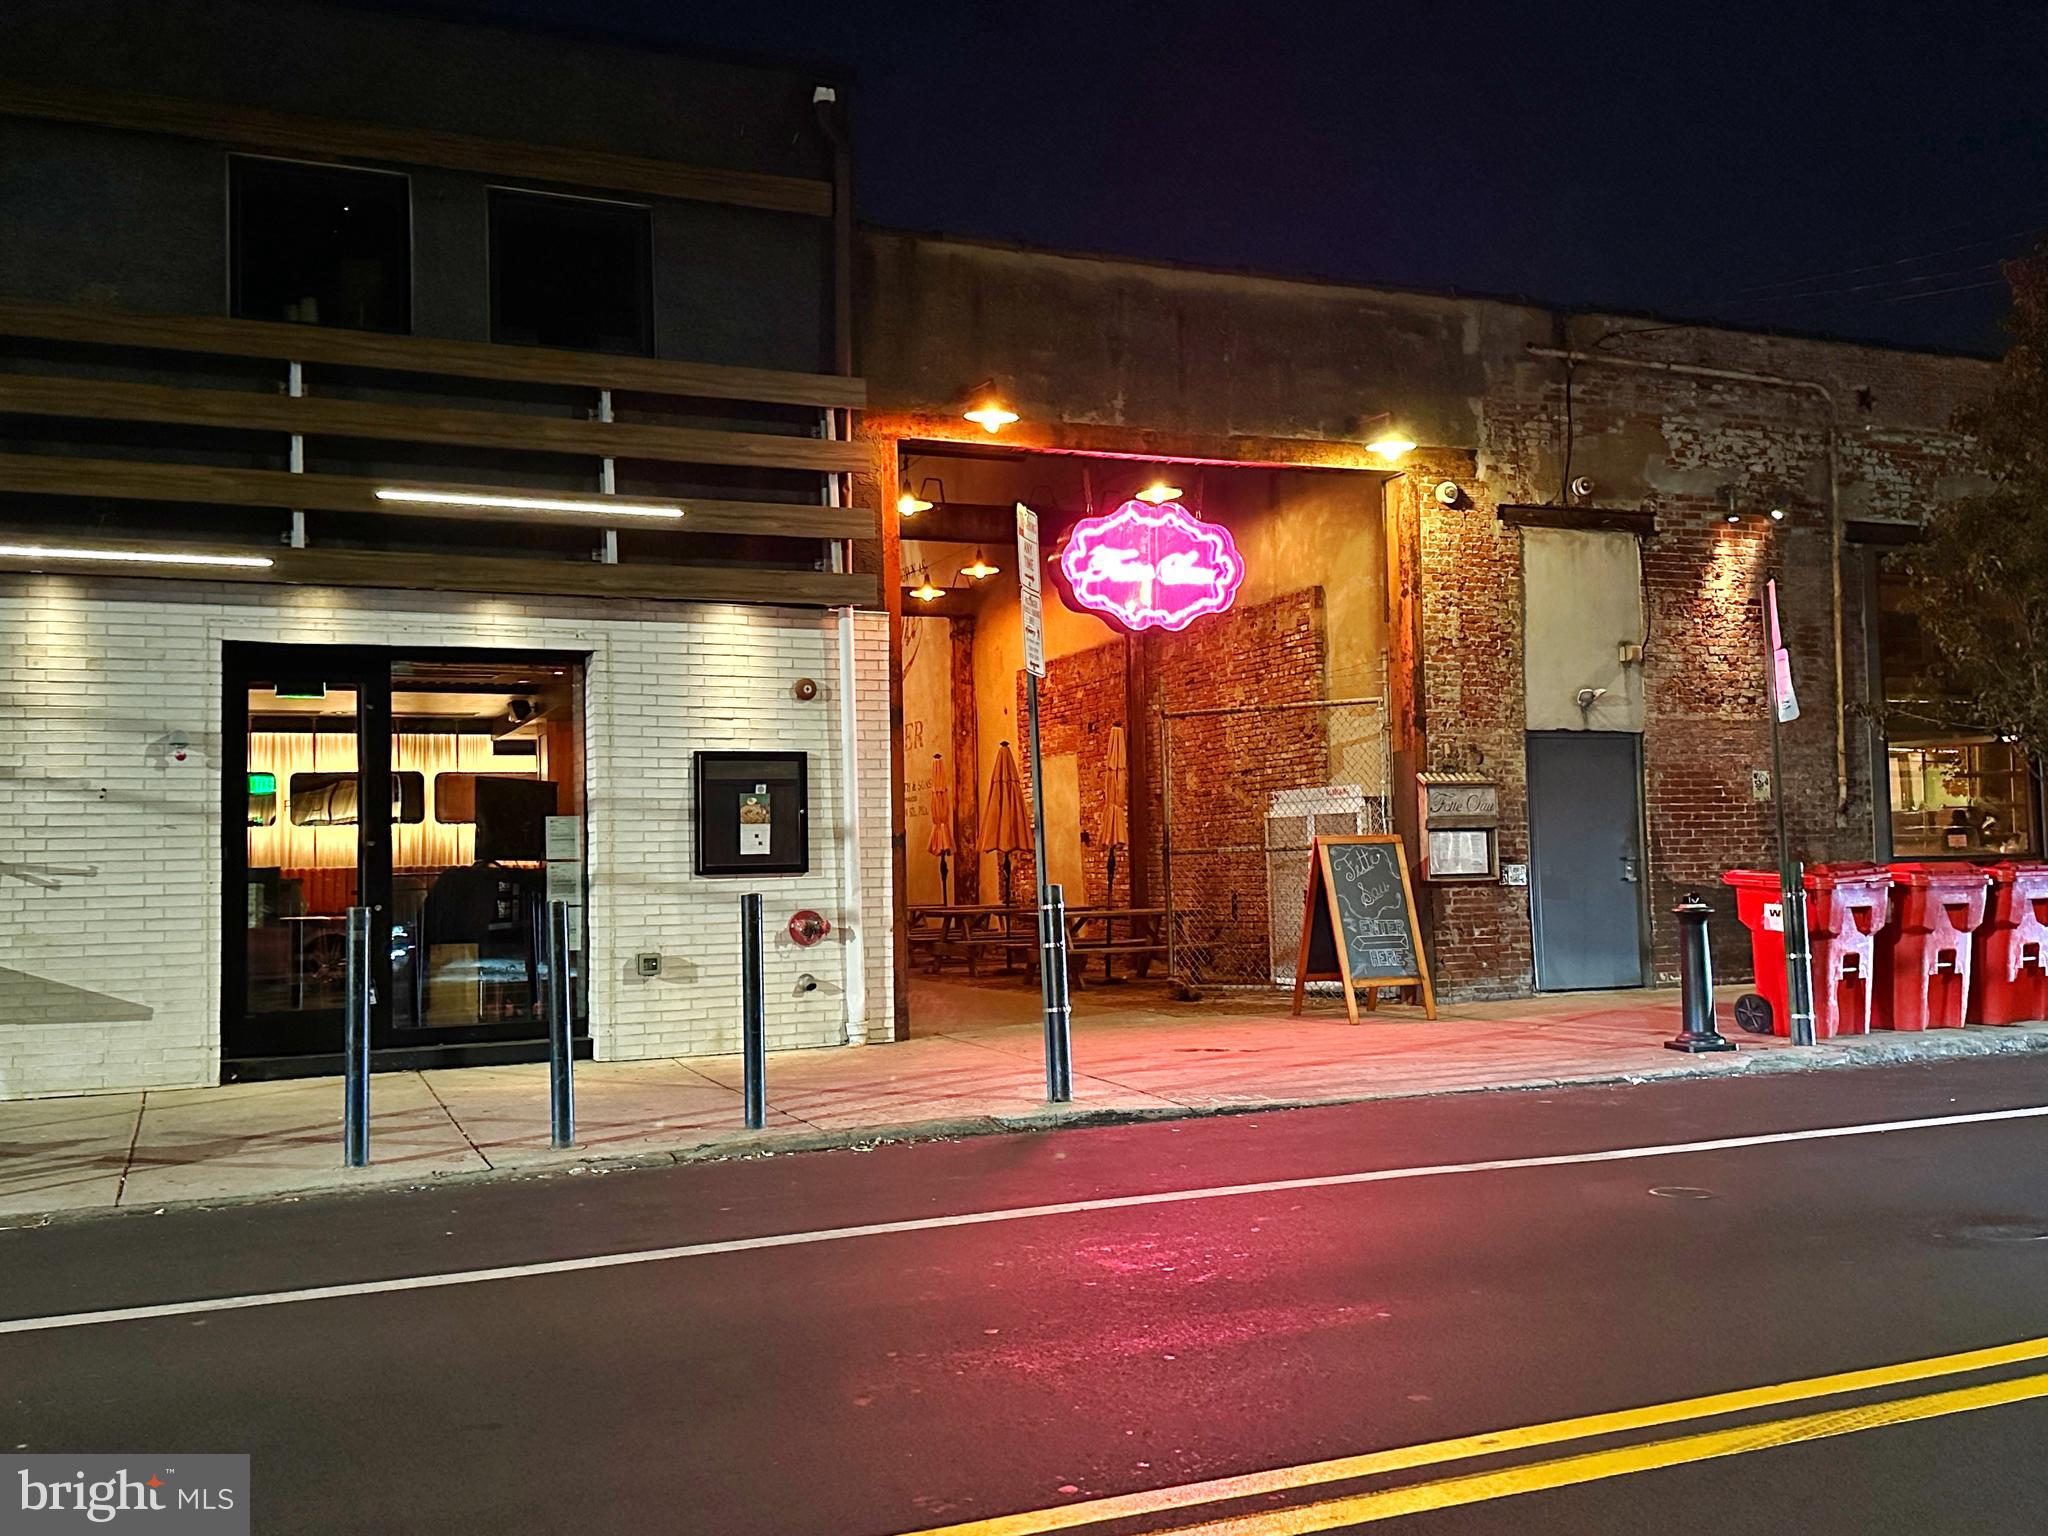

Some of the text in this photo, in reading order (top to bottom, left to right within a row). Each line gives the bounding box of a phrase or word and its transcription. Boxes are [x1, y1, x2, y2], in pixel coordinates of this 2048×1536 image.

[1334, 848, 1381, 882] Fette
[1357, 881, 1391, 908] Sau
[1359, 919, 1405, 937] ENTER
[1369, 949, 1407, 967] HERE
